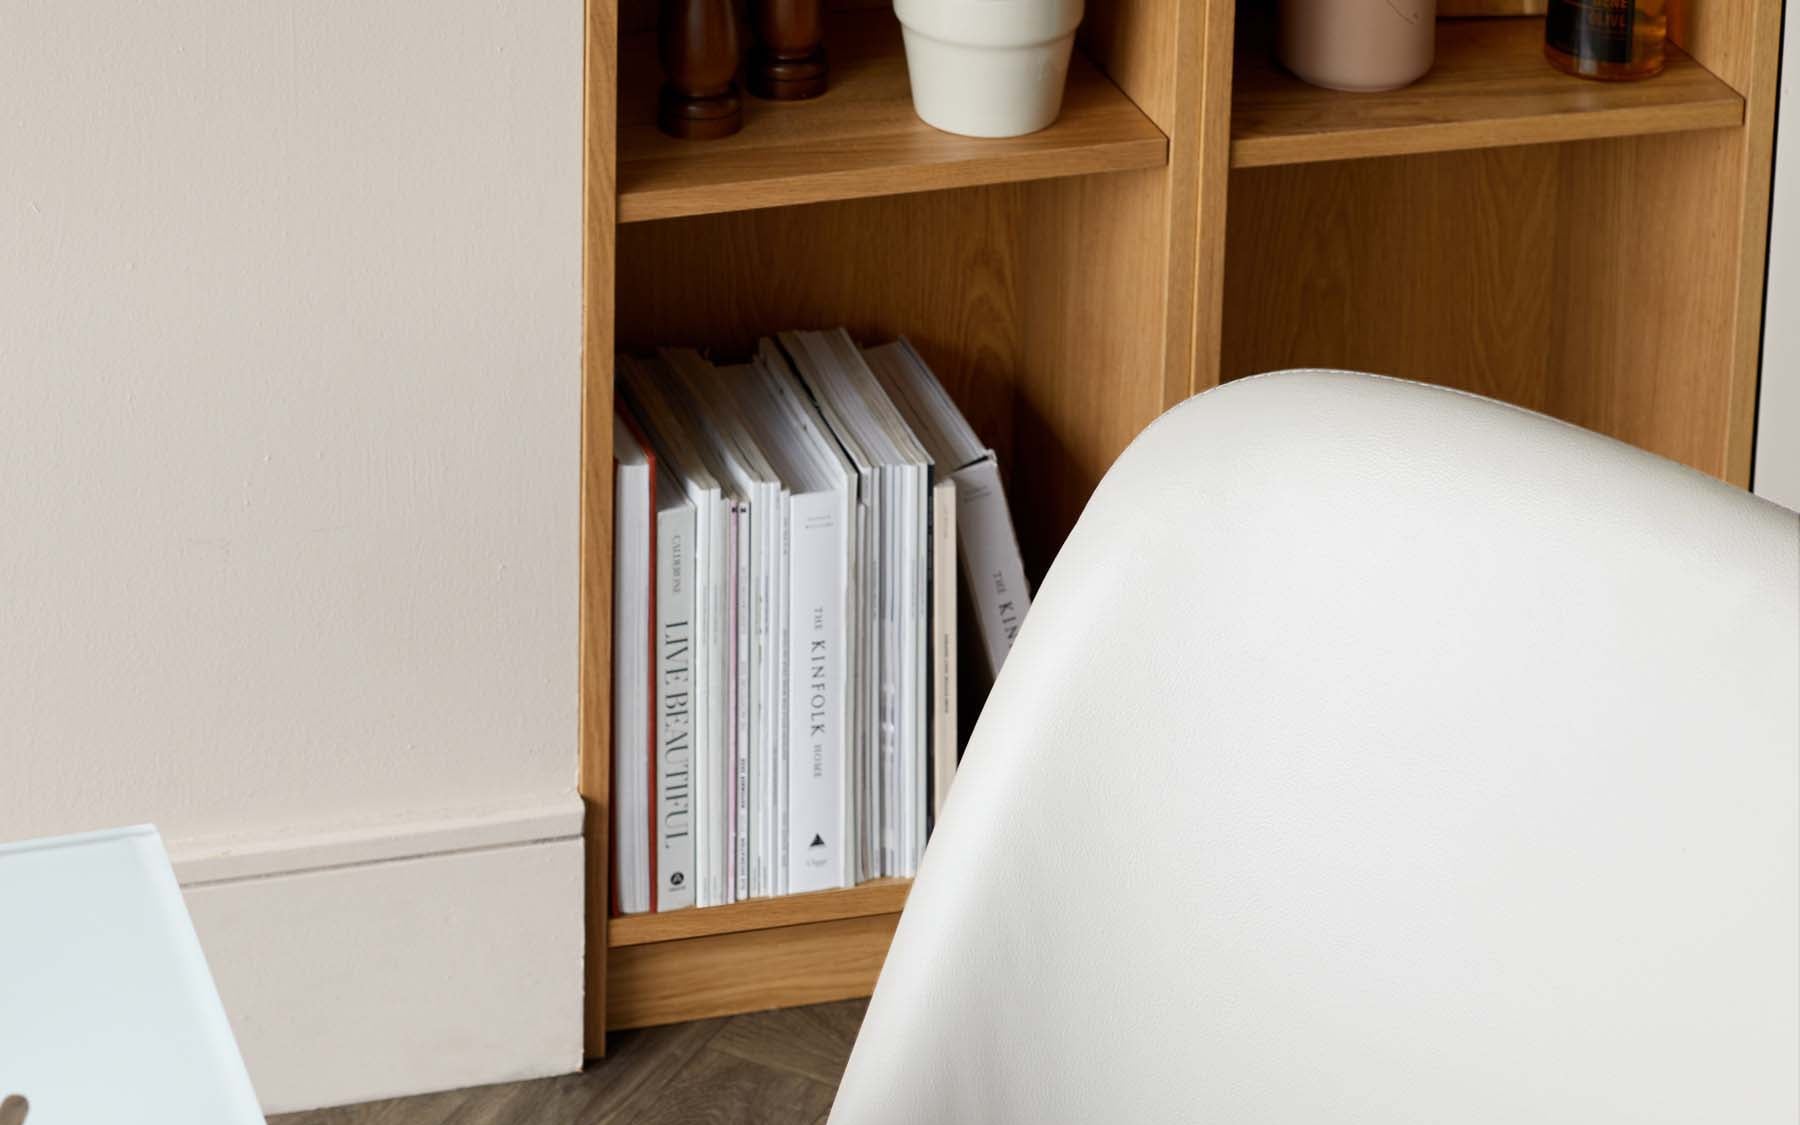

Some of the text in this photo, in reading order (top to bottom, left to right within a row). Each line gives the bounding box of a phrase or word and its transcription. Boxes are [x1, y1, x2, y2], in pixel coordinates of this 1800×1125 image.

[811, 607, 827, 778] THE KINFOLK HOME
[999, 601, 1018, 648] KIN
[664, 620, 689, 849] LIVE BEAUTIFUL
